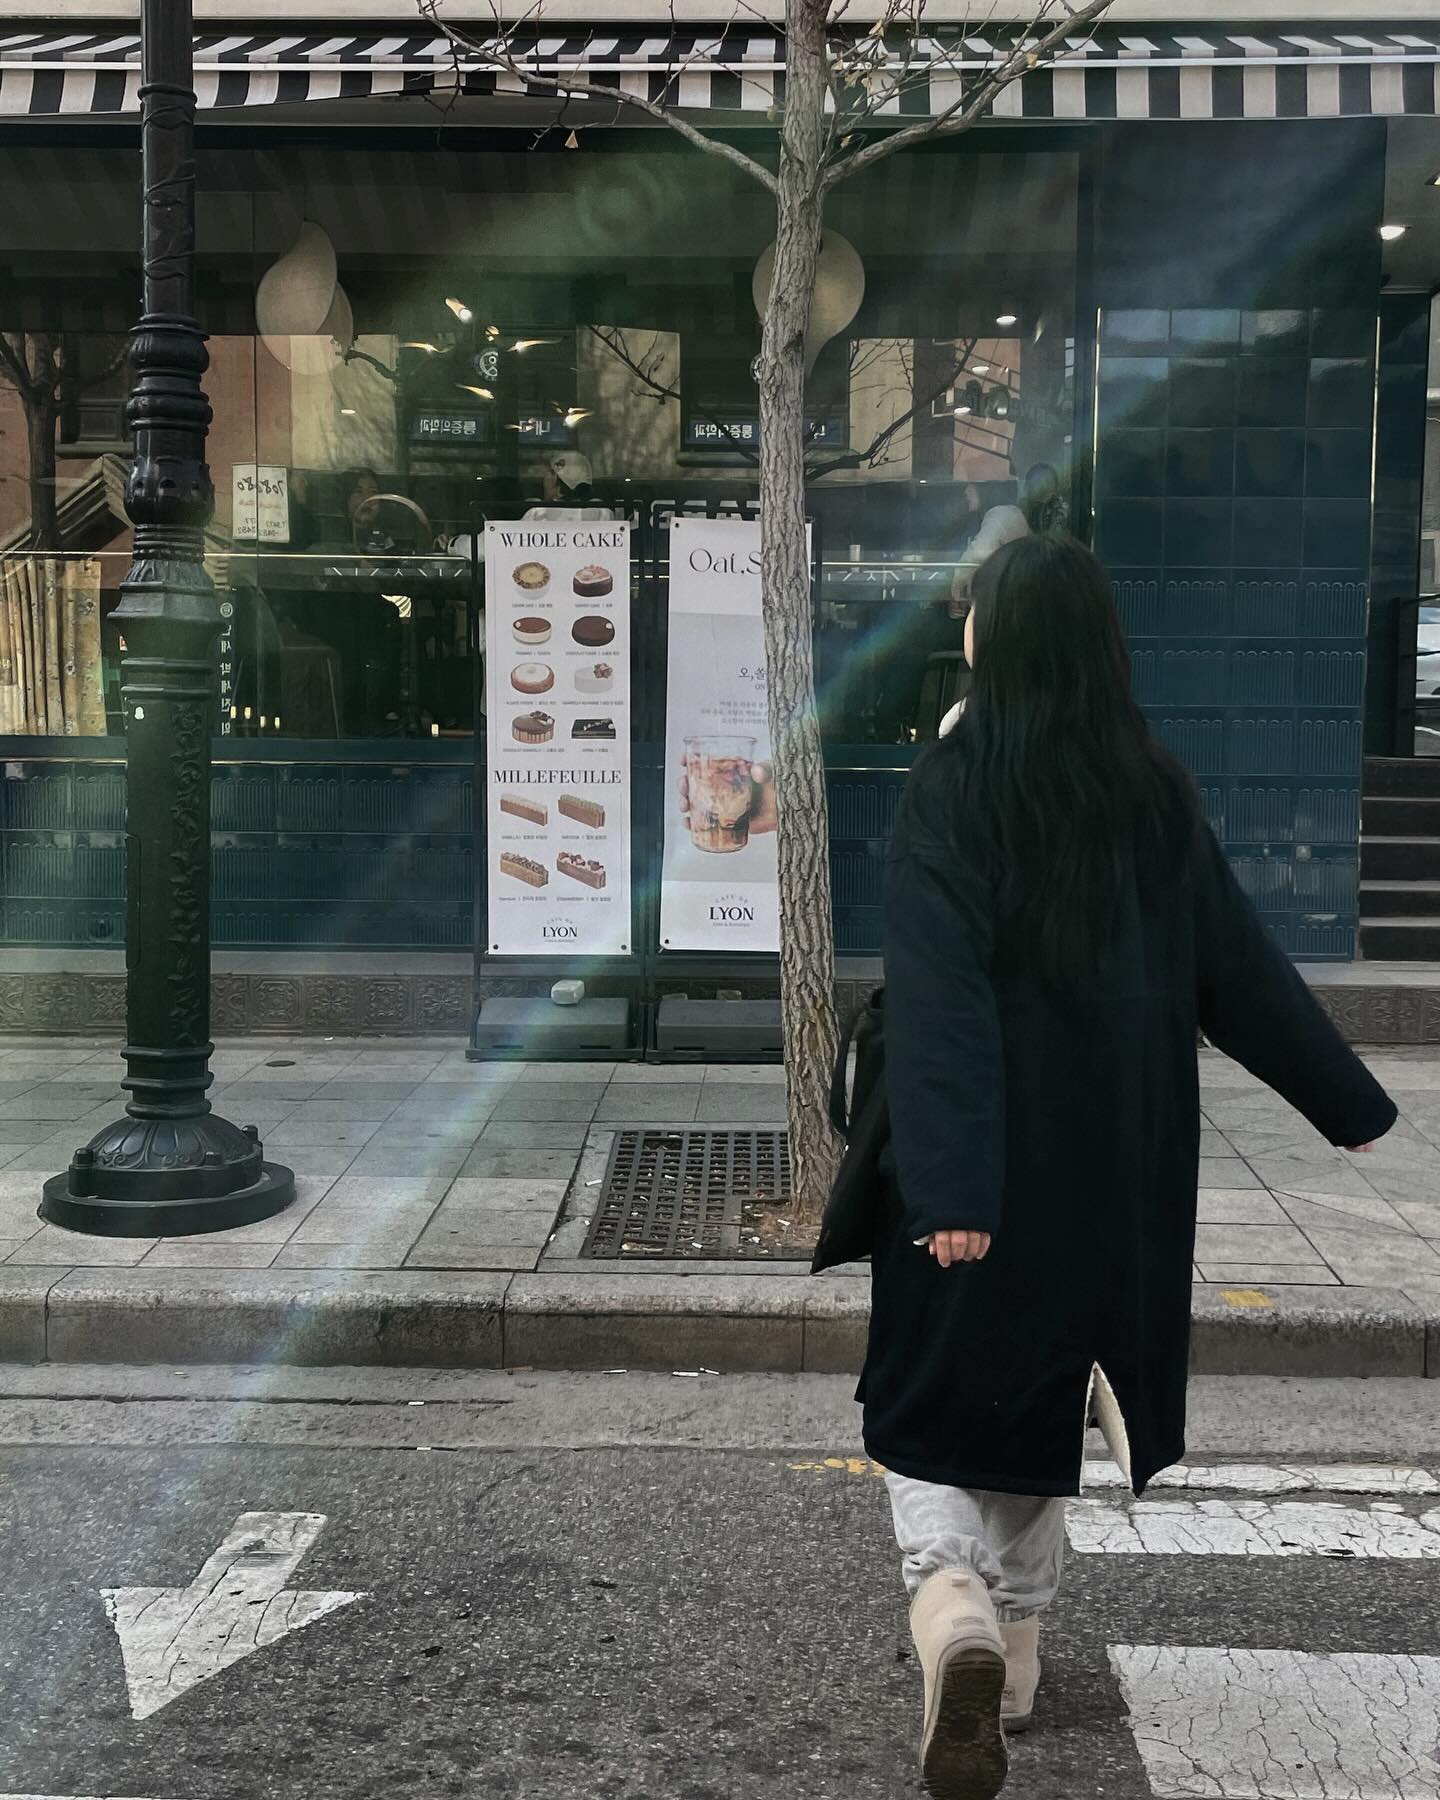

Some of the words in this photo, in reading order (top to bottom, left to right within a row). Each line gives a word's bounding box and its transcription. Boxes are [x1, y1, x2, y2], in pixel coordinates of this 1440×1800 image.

[501, 532, 567, 548] WHOLE
[573, 532, 624, 548] CAKE
[493, 770, 622, 784] MILLEFEUILLE
[709, 906, 754, 921] LYON
[543, 926, 578, 938] LYON
